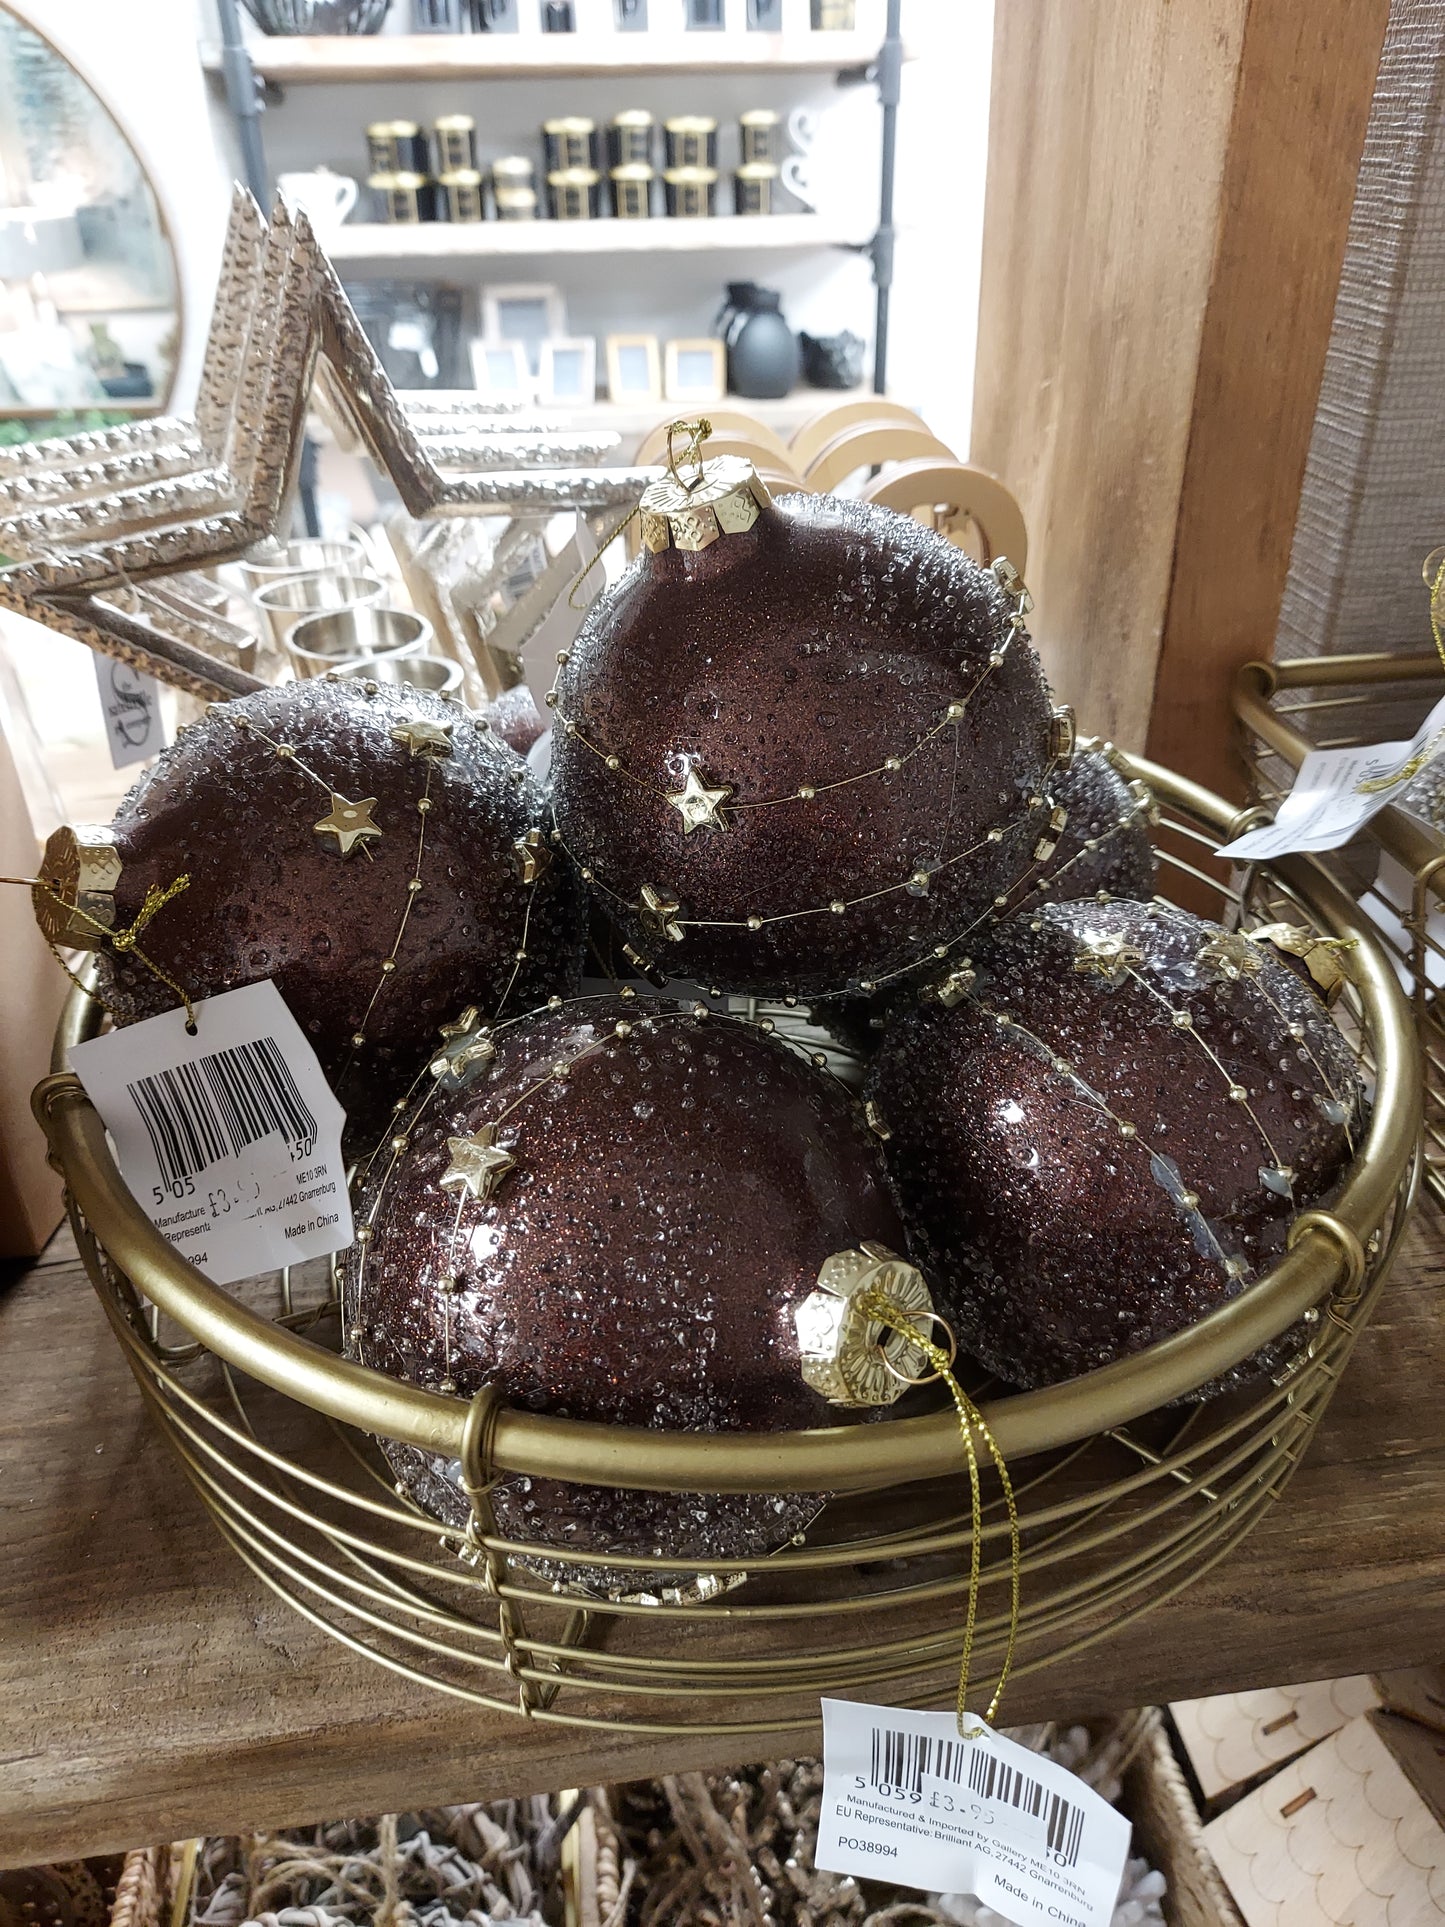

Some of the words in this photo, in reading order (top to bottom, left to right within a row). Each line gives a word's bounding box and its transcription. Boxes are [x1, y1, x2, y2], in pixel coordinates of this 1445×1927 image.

[152, 1186, 164, 1205] 5
[284, 1223, 306, 1239] Made
[307, 1220, 315, 1232] in
[316, 1213, 339, 1229] China
[854, 1776, 866, 1789] 5
[836, 1804, 852, 1818] EU
[854, 1809, 934, 1837] Representative:
[934, 1830, 972, 1848] Brilliant
[995, 1850, 1027, 1873] 27442
[838, 1836, 898, 1858] PO38994
[847, 1794, 915, 1820] Manufactured
[918, 1815, 926, 1823] &
[929, 1817, 974, 1837] Imported
[977, 1831, 989, 1843] by
[992, 1839, 1027, 1862] Gallery
[1030, 1858, 1060, 1879] ME10
[994, 1873, 1029, 1902] Made
[1032, 1896, 1044, 1911] in
